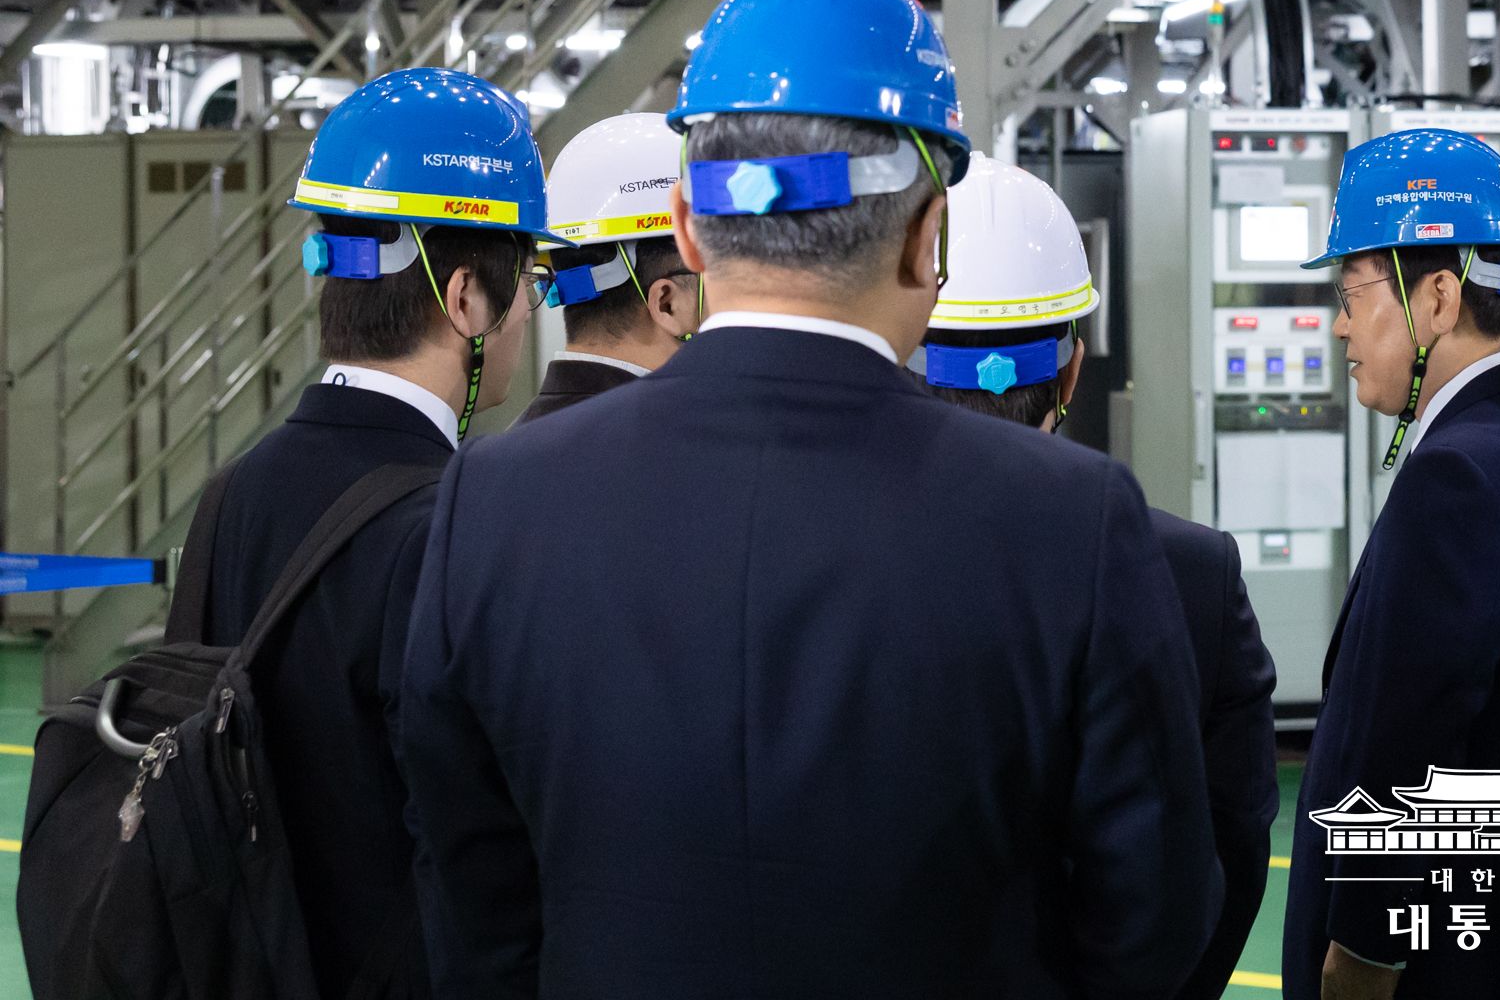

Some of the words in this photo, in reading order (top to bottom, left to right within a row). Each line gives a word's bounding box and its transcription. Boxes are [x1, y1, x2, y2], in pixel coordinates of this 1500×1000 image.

[1408, 178, 1438, 191] KFE
[1375, 191, 1473, 207] 한국핵융합에너지연구원
[444, 200, 490, 216] KSTAR
[637, 215, 673, 229] KSTA
